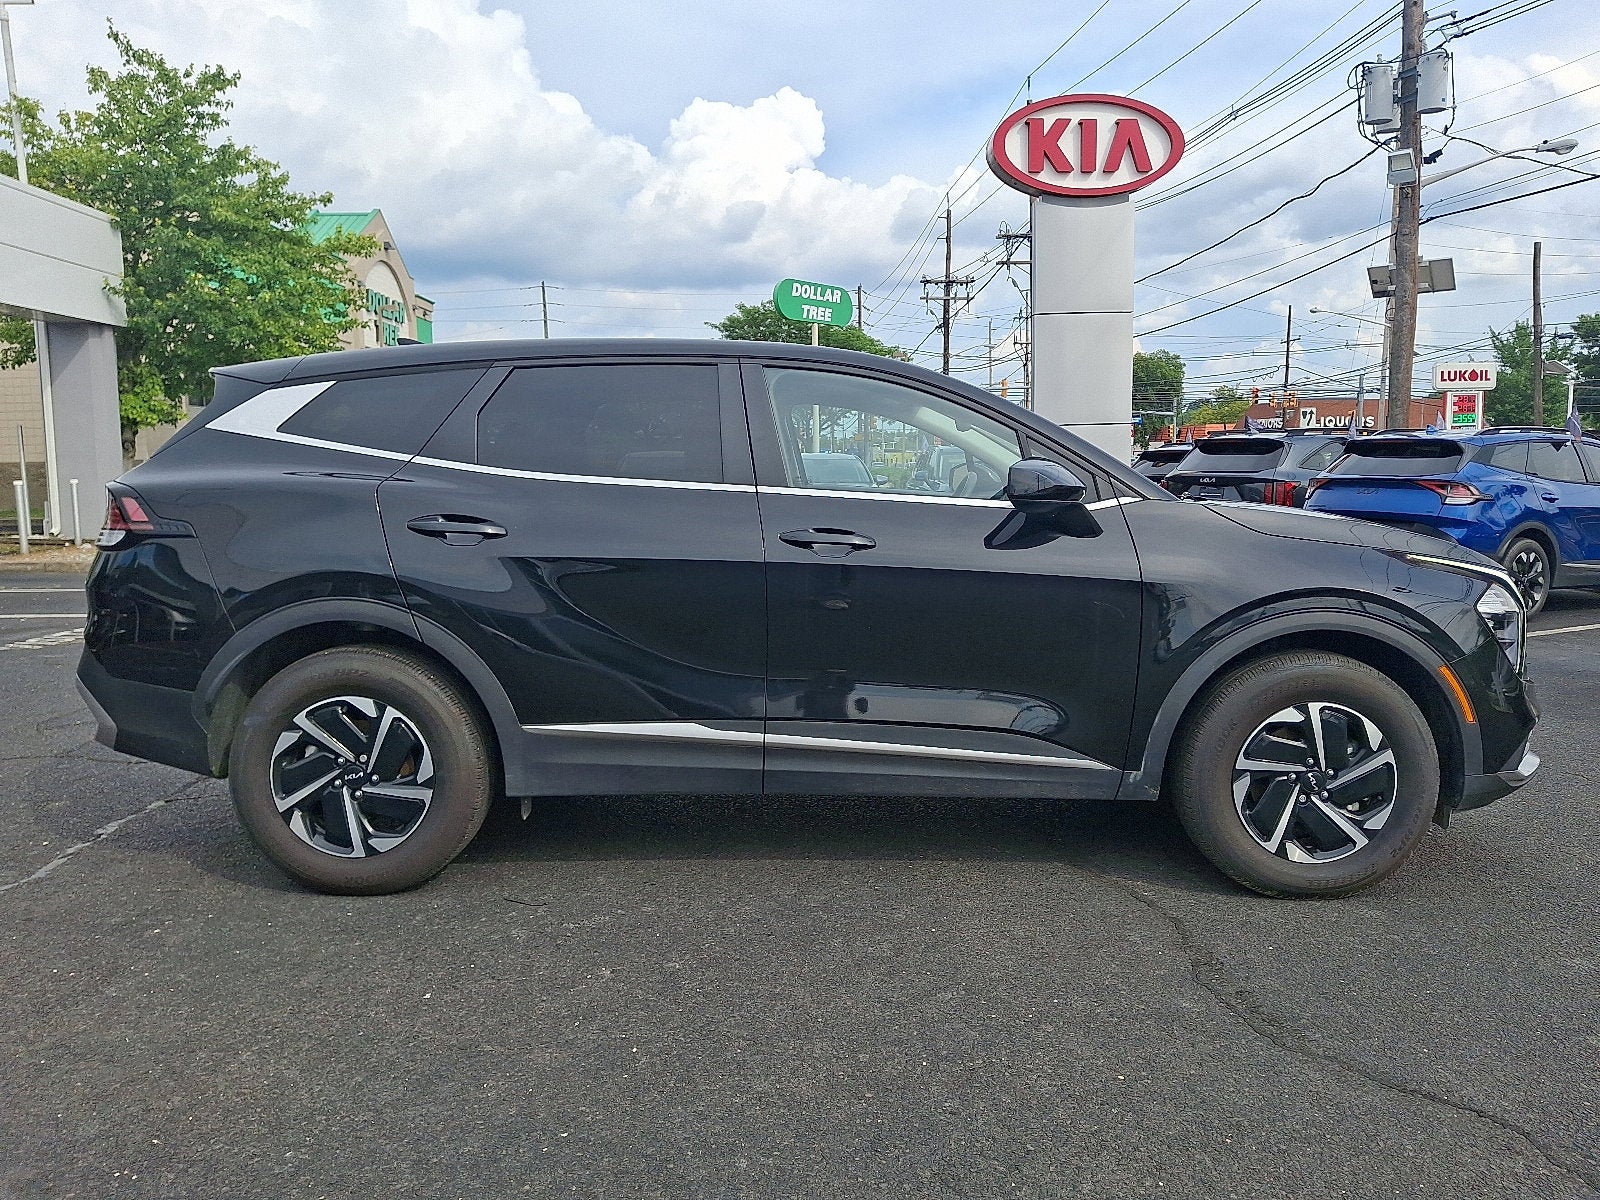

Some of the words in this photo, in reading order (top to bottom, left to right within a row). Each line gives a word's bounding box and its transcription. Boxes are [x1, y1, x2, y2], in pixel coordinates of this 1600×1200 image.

[1025, 117, 1153, 174] KIA
[791, 282, 842, 304] DOLLAR
[367, 288, 405, 324] DOLLAR
[802, 304, 833, 322] TREE
[375, 320, 400, 346] REE
[1440, 368, 1491, 382] LUKOIL
[344, 771, 364, 780] KIA
